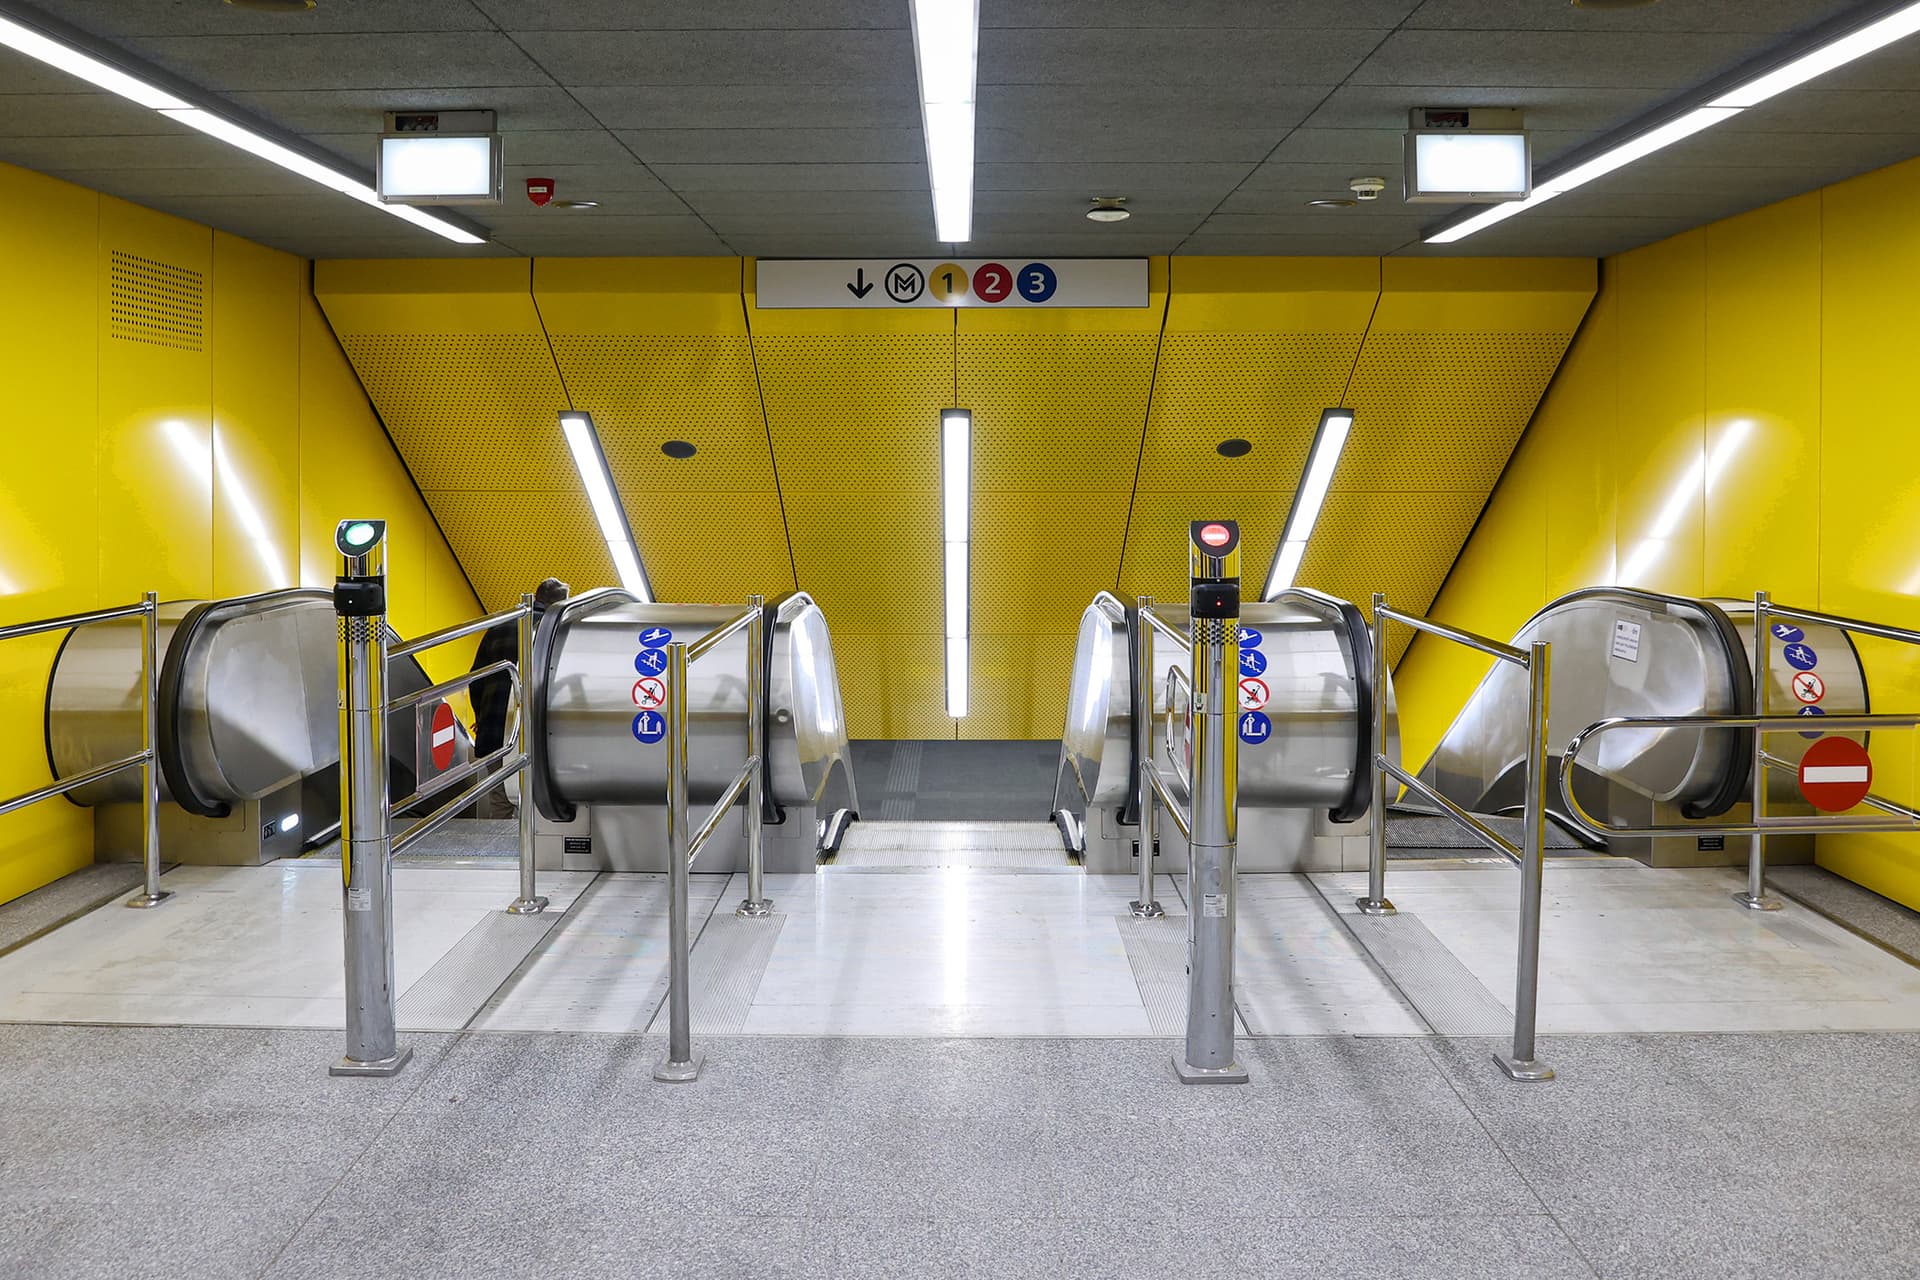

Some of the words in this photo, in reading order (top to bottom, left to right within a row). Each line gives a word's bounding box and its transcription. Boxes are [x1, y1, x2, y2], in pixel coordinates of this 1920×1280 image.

[942, 272, 953, 294] 1
[985, 272, 1001, 294] 2
[1029, 272, 1045, 294] 3
